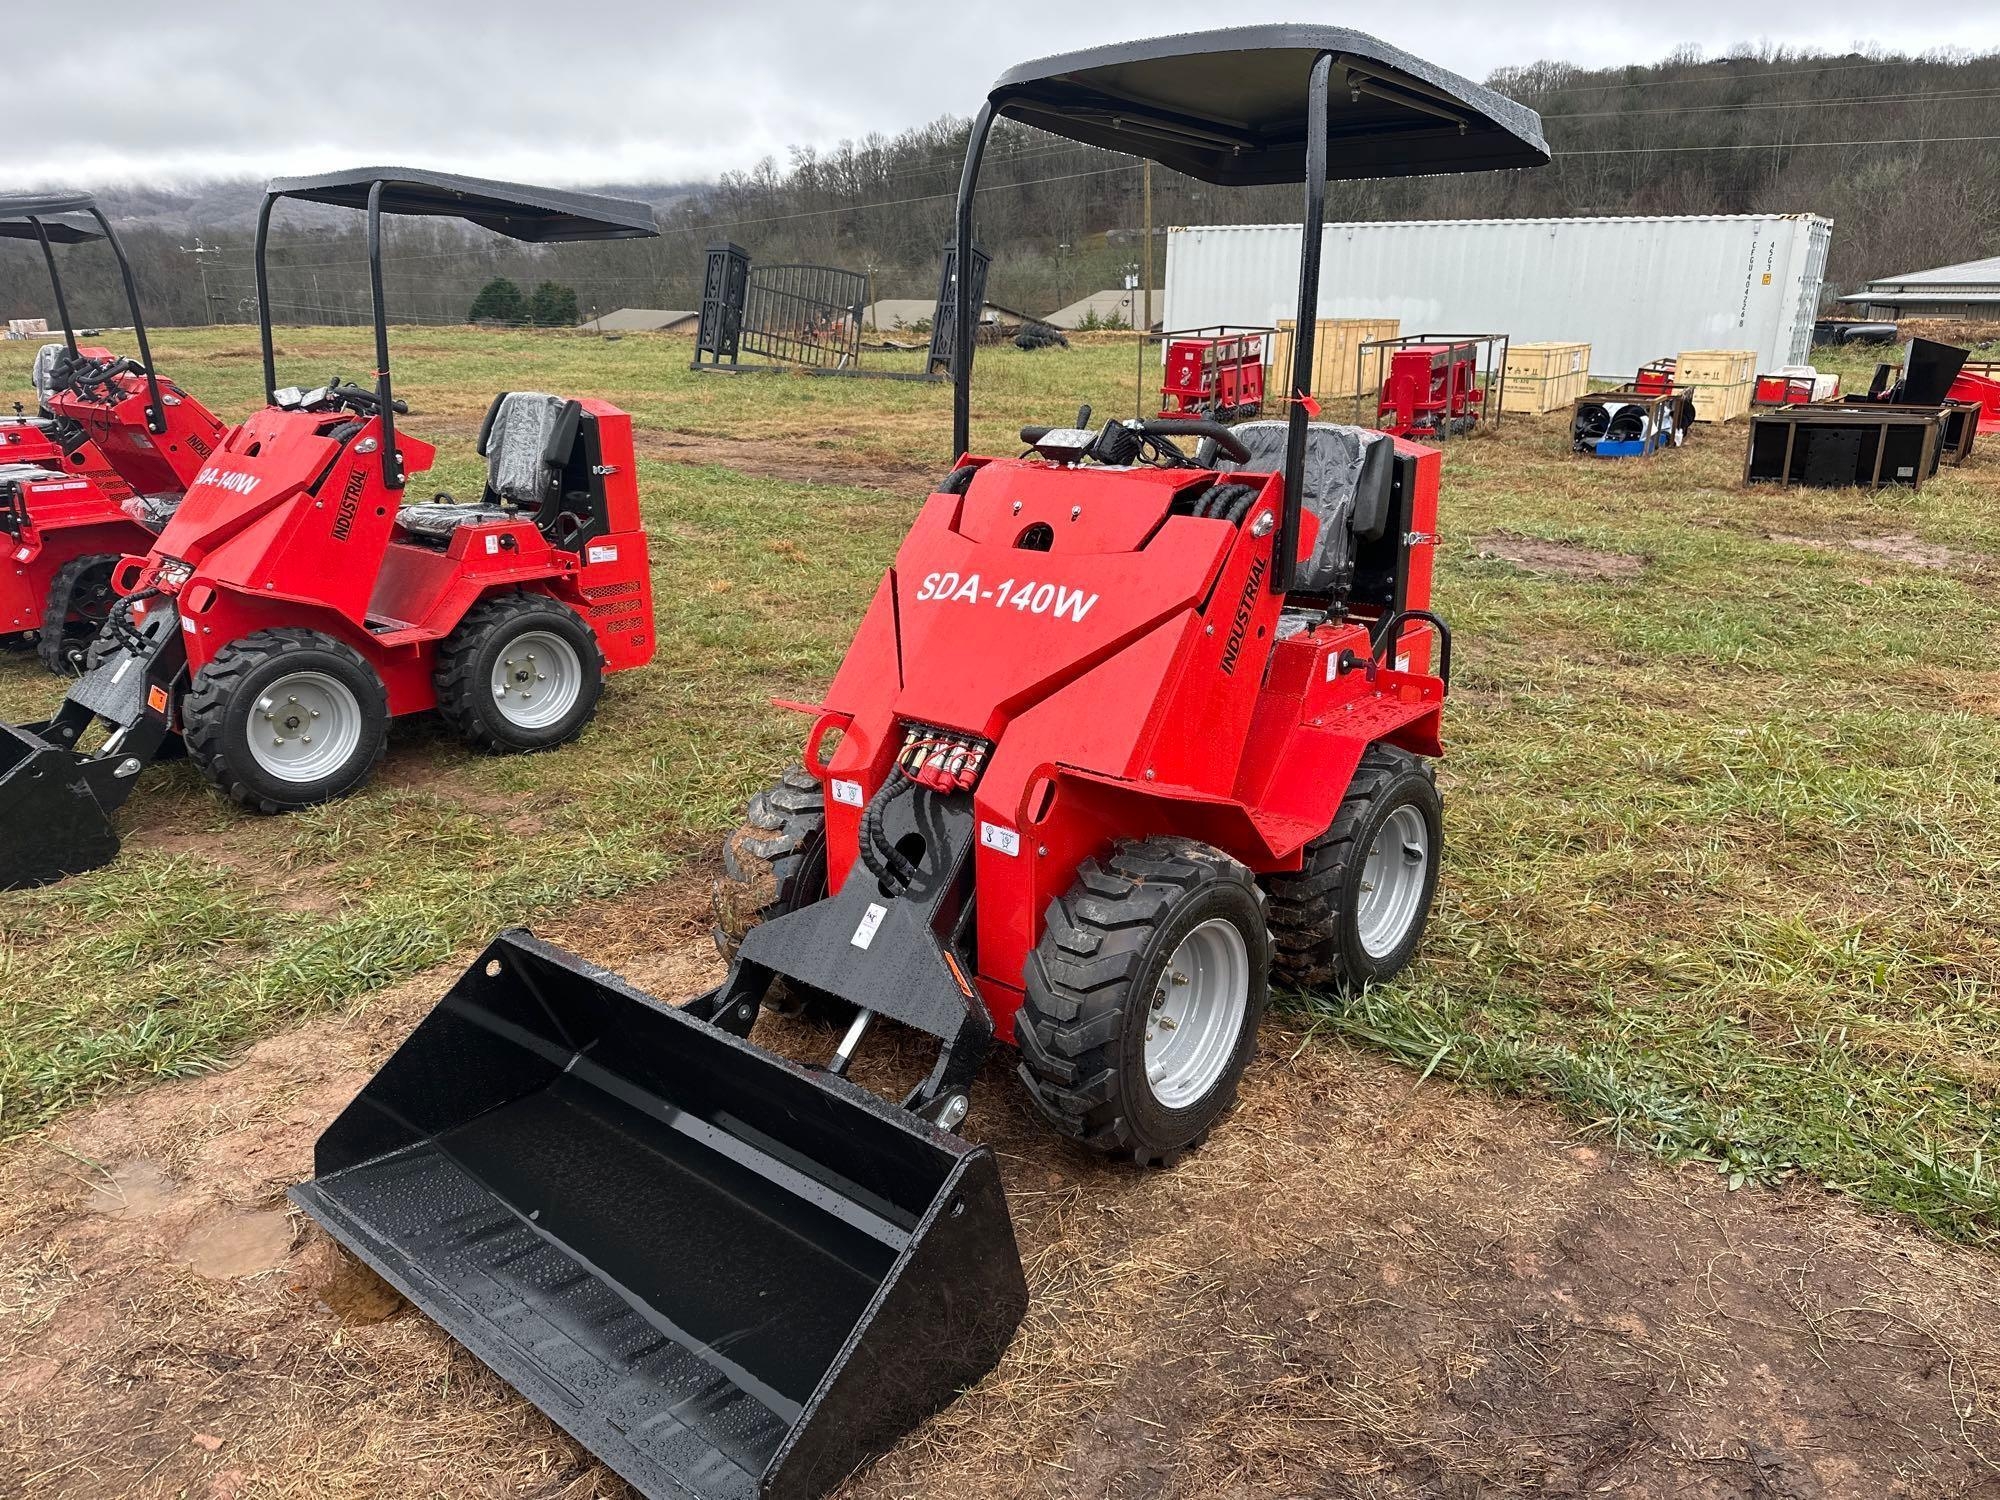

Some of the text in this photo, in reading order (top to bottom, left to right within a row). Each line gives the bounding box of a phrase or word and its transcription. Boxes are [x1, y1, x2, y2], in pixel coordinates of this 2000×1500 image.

[186, 434, 213, 461] INDUS
[332, 469, 367, 542] INDUSTRIAL
[916, 572, 1100, 623] SDA-140W
[1221, 556, 1268, 676] INDUSTRIAL
